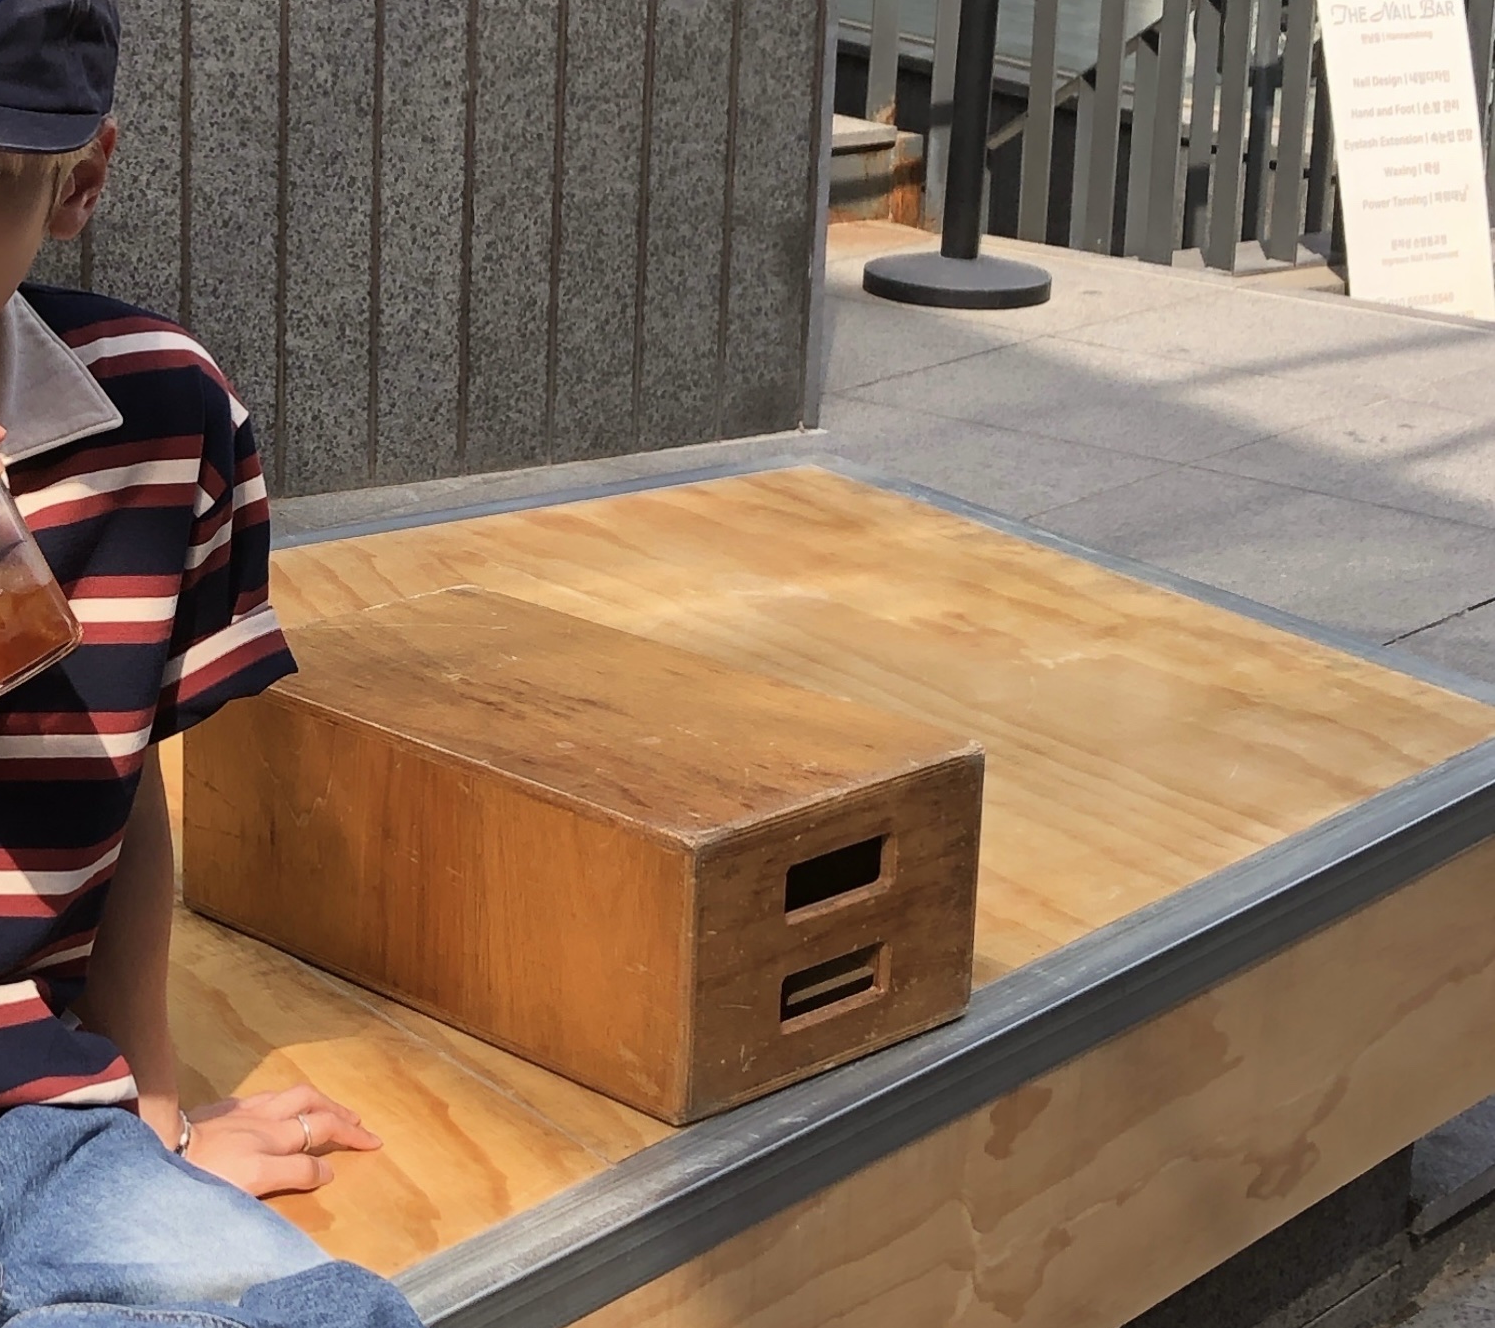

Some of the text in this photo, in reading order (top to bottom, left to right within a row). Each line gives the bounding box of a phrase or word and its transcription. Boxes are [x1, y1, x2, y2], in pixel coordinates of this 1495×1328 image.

[1369, 0, 1417, 23] NAIL
[1352, 76, 1371, 88] Nail
[1372, 73, 1402, 88] Design
[1350, 106, 1374, 119] Hand
[1376, 105, 1393, 117] and
[1395, 103, 1416, 115] Foot
